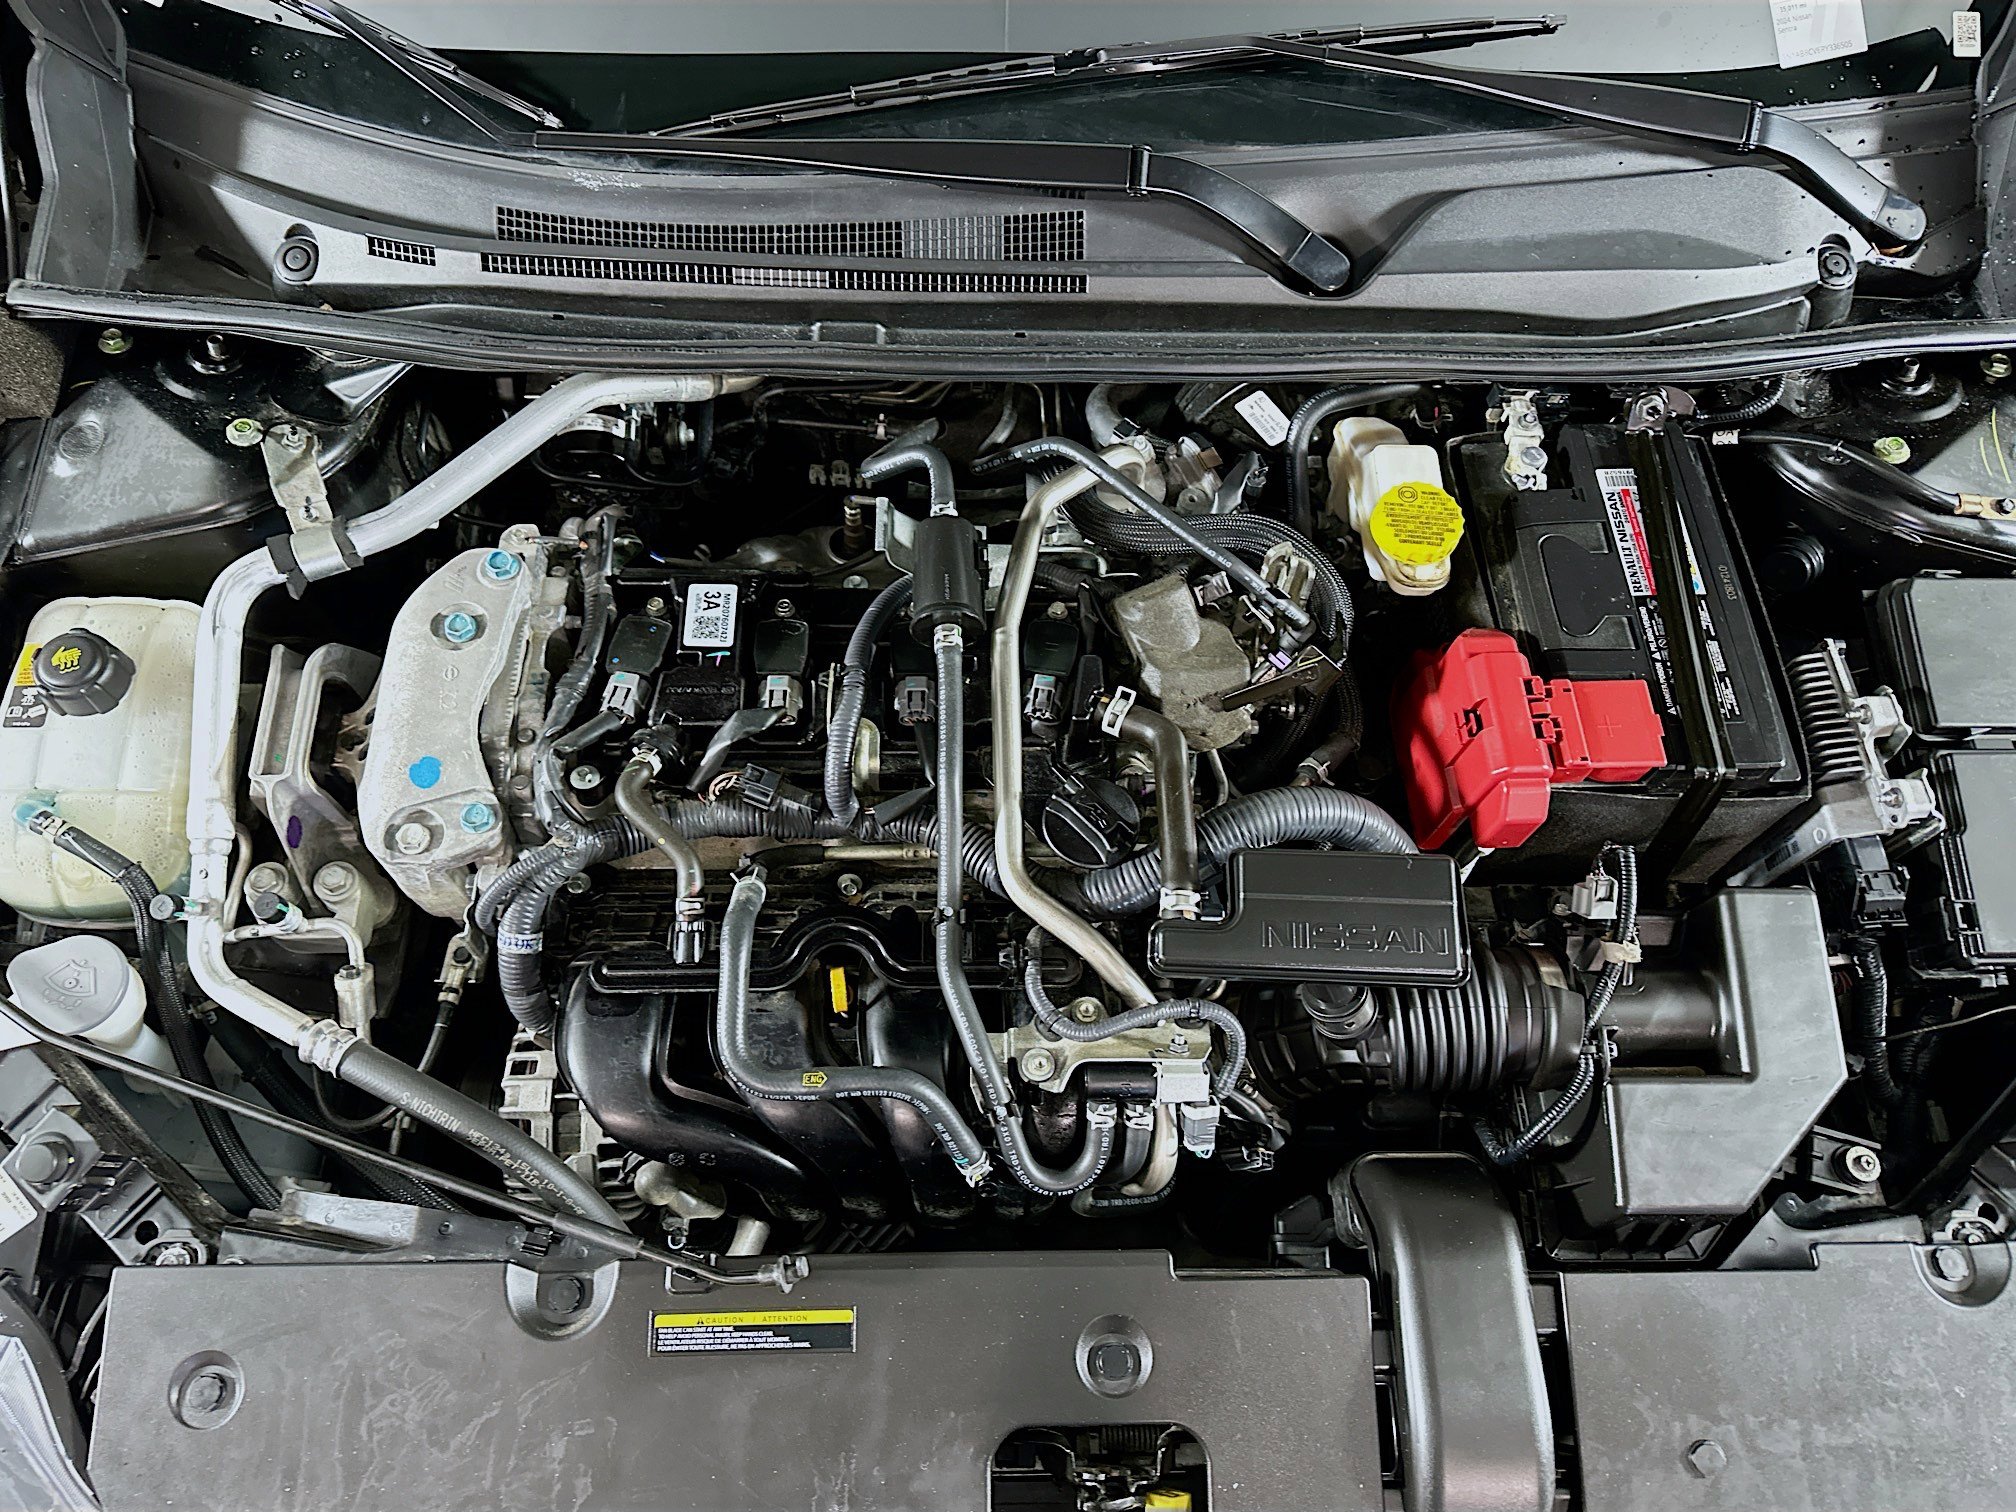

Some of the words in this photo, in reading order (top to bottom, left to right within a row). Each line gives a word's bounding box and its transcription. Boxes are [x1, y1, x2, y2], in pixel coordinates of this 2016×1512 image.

[1605, 491, 1628, 543] NISSAN
[1621, 546, 1643, 593] RENAULT
[703, 591, 721, 611] 3A
[1261, 921, 1450, 955] NISSAN
[805, 1074, 822, 1084] ENG
[705, 1316, 744, 1324] CAUTION
[762, 1315, 808, 1323] ATTENTION
